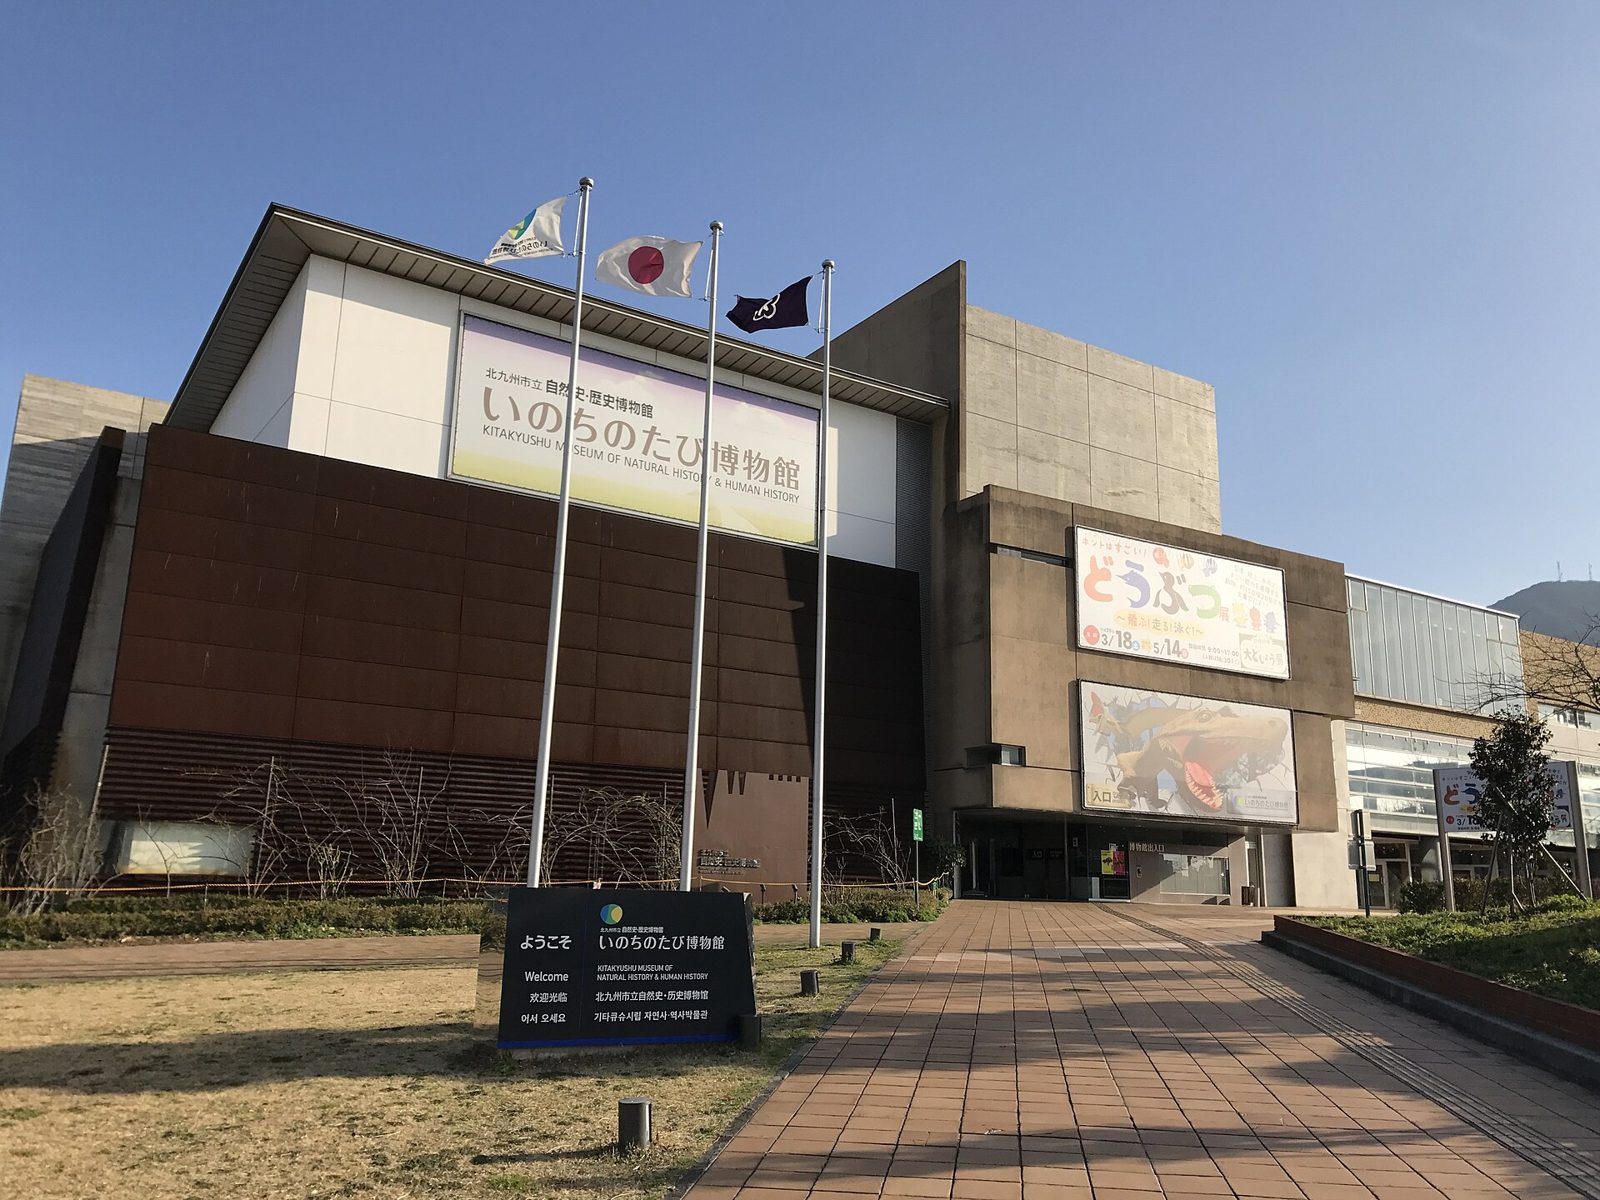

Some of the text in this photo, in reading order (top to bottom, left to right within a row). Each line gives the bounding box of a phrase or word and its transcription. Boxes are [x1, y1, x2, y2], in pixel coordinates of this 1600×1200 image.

[486, 368, 542, 391] 北九州市立
[482, 424, 552, 448] KITAKYUSHU
[556, 440, 604, 460] MSEUM
[608, 452, 621, 464] OF
[624, 457, 669, 476] NATURAL
[715, 478, 722, 488] &
[725, 480, 760, 496] HUMAN
[763, 488, 800, 504] HISTORY
[1102, 630, 1132, 649] 3/18
[1153, 638, 1180, 657] 5/14
[1093, 791, 1111, 802] 入口
[520, 935, 572, 950] ようこそ
[599, 935, 725, 950] いのちのたび博物館
[525, 971, 569, 982] Welcome
[529, 992, 568, 1003] 欢迎光临
[521, 1013, 566, 1024] 어서 오세요
[594, 1012, 641, 1022] 기타큐슈시립
